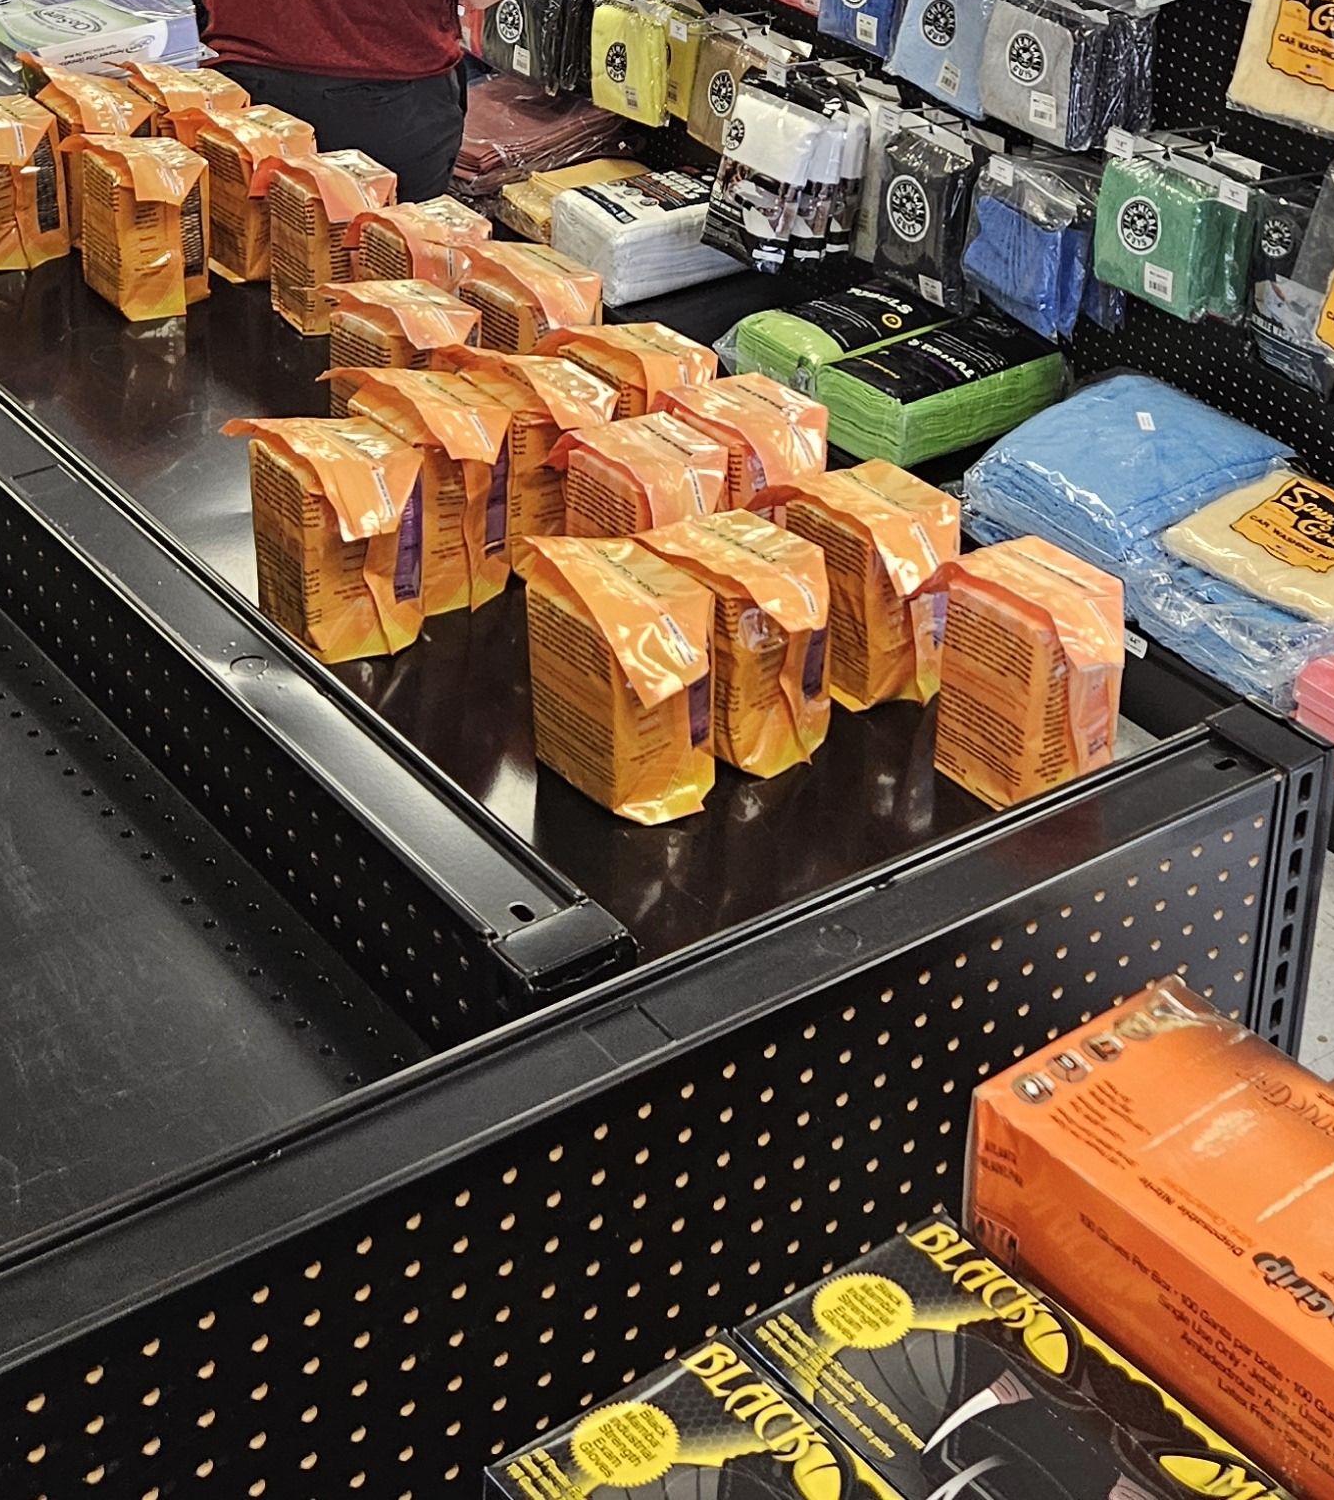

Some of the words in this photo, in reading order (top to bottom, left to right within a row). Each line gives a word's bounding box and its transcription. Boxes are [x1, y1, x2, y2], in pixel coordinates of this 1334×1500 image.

[1011, 36, 1043, 64] CHEMICAL
[1278, 33, 1297, 46] CAR
[894, 183, 924, 218] CHEMICAL
[1125, 205, 1156, 236] CHEMICAL
[1249, 515, 1270, 528] CAR
[1272, 527, 1315, 554] WASHING
[1174, 1200, 1246, 1258] Disposable
[874, 1281, 903, 1307] Black
[904, 1222, 1053, 1329] BLACK
[833, 1304, 863, 1334] Exam
[837, 1292, 882, 1332] Strength
[846, 1286, 895, 1328] Industrial
[861, 1283, 901, 1316] Mamba
[820, 1309, 856, 1342] Gloves
[1129, 1254, 1153, 1276] Per
[1176, 1292, 1201, 1314] 100
[1289, 1381, 1314, 1403] 100
[1187, 1320, 1216, 1346] Use
[1210, 1339, 1243, 1368] Only
[680, 1341, 828, 1462] BLACK
[1214, 1378, 1252, 1411] Latex
[1246, 1403, 1279, 1431] Free
[609, 1415, 658, 1463] Industrial
[623, 1409, 660, 1449] Mamba
[638, 1408, 670, 1440] Black
[578, 1440, 616, 1480] Gloves
[592, 1437, 623, 1469] Exam
[598, 1421, 642, 1468] Strength
